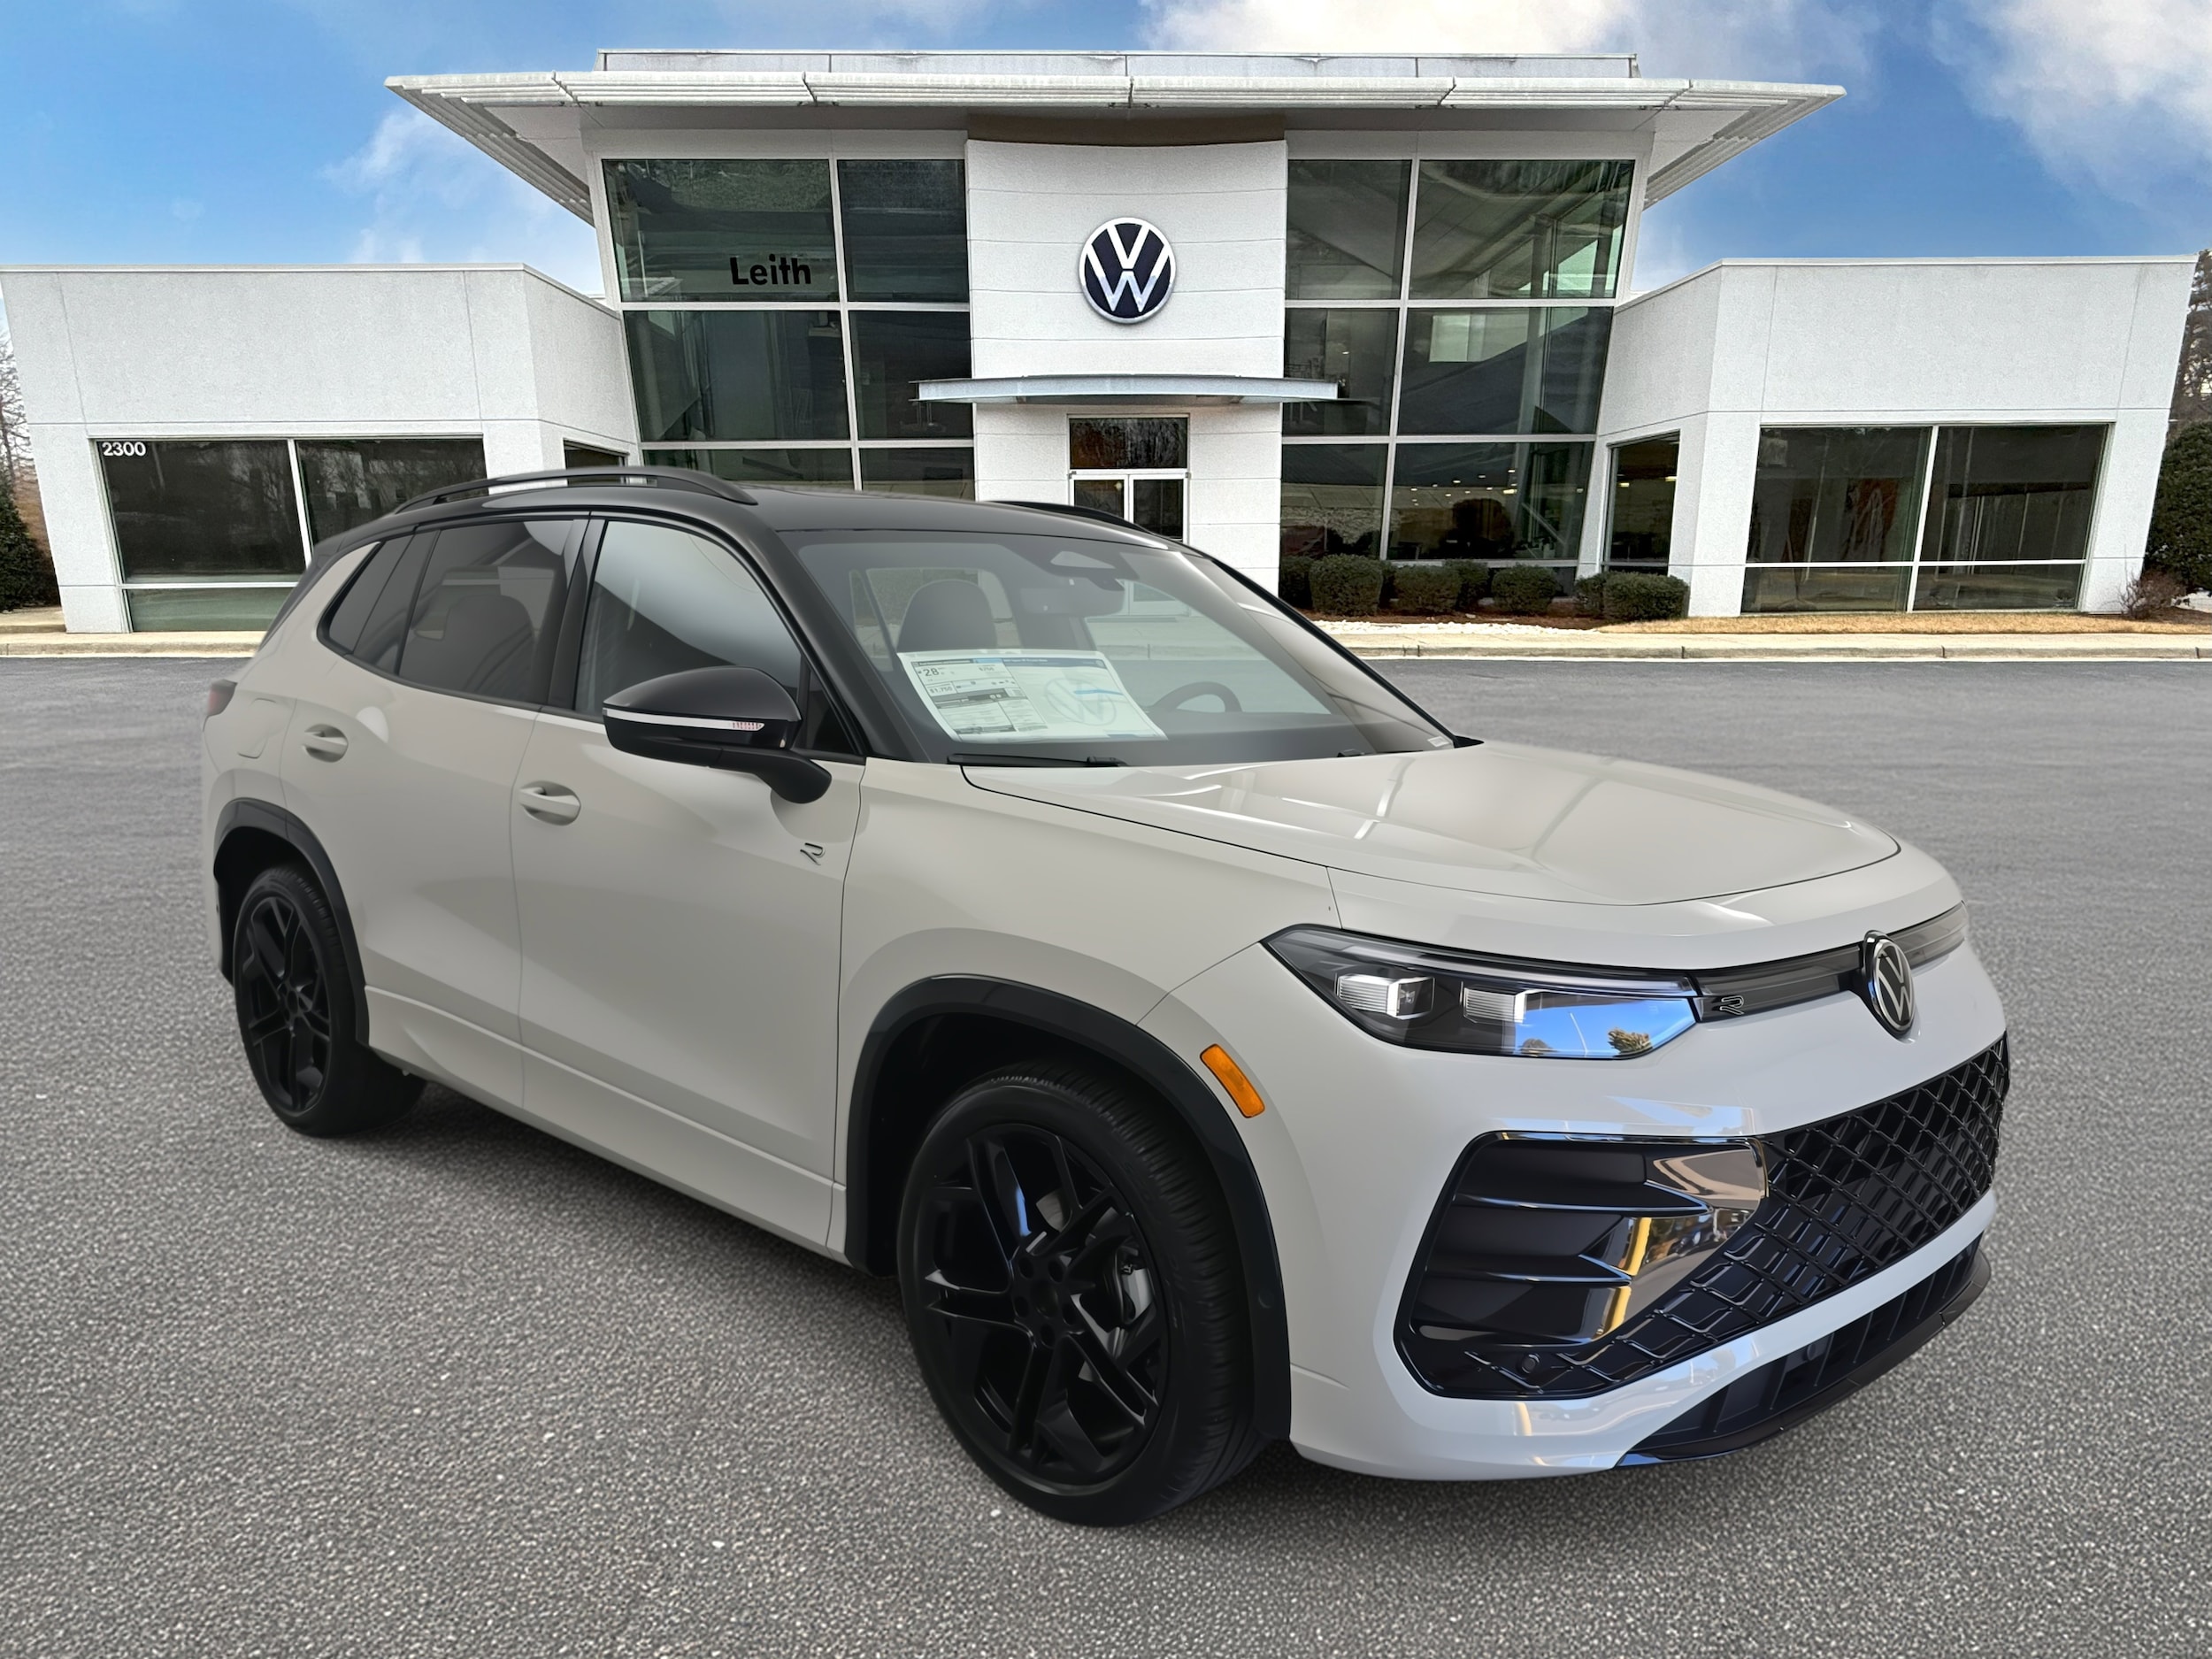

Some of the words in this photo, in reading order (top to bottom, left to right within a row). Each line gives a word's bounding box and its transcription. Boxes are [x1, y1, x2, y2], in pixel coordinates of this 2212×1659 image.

[730, 254, 811, 285] Leith
[1080, 218, 1175, 321] VW
[102, 442, 146, 456] 2300
[923, 667, 940, 677] 28
[1874, 939, 1914, 1031] VW
